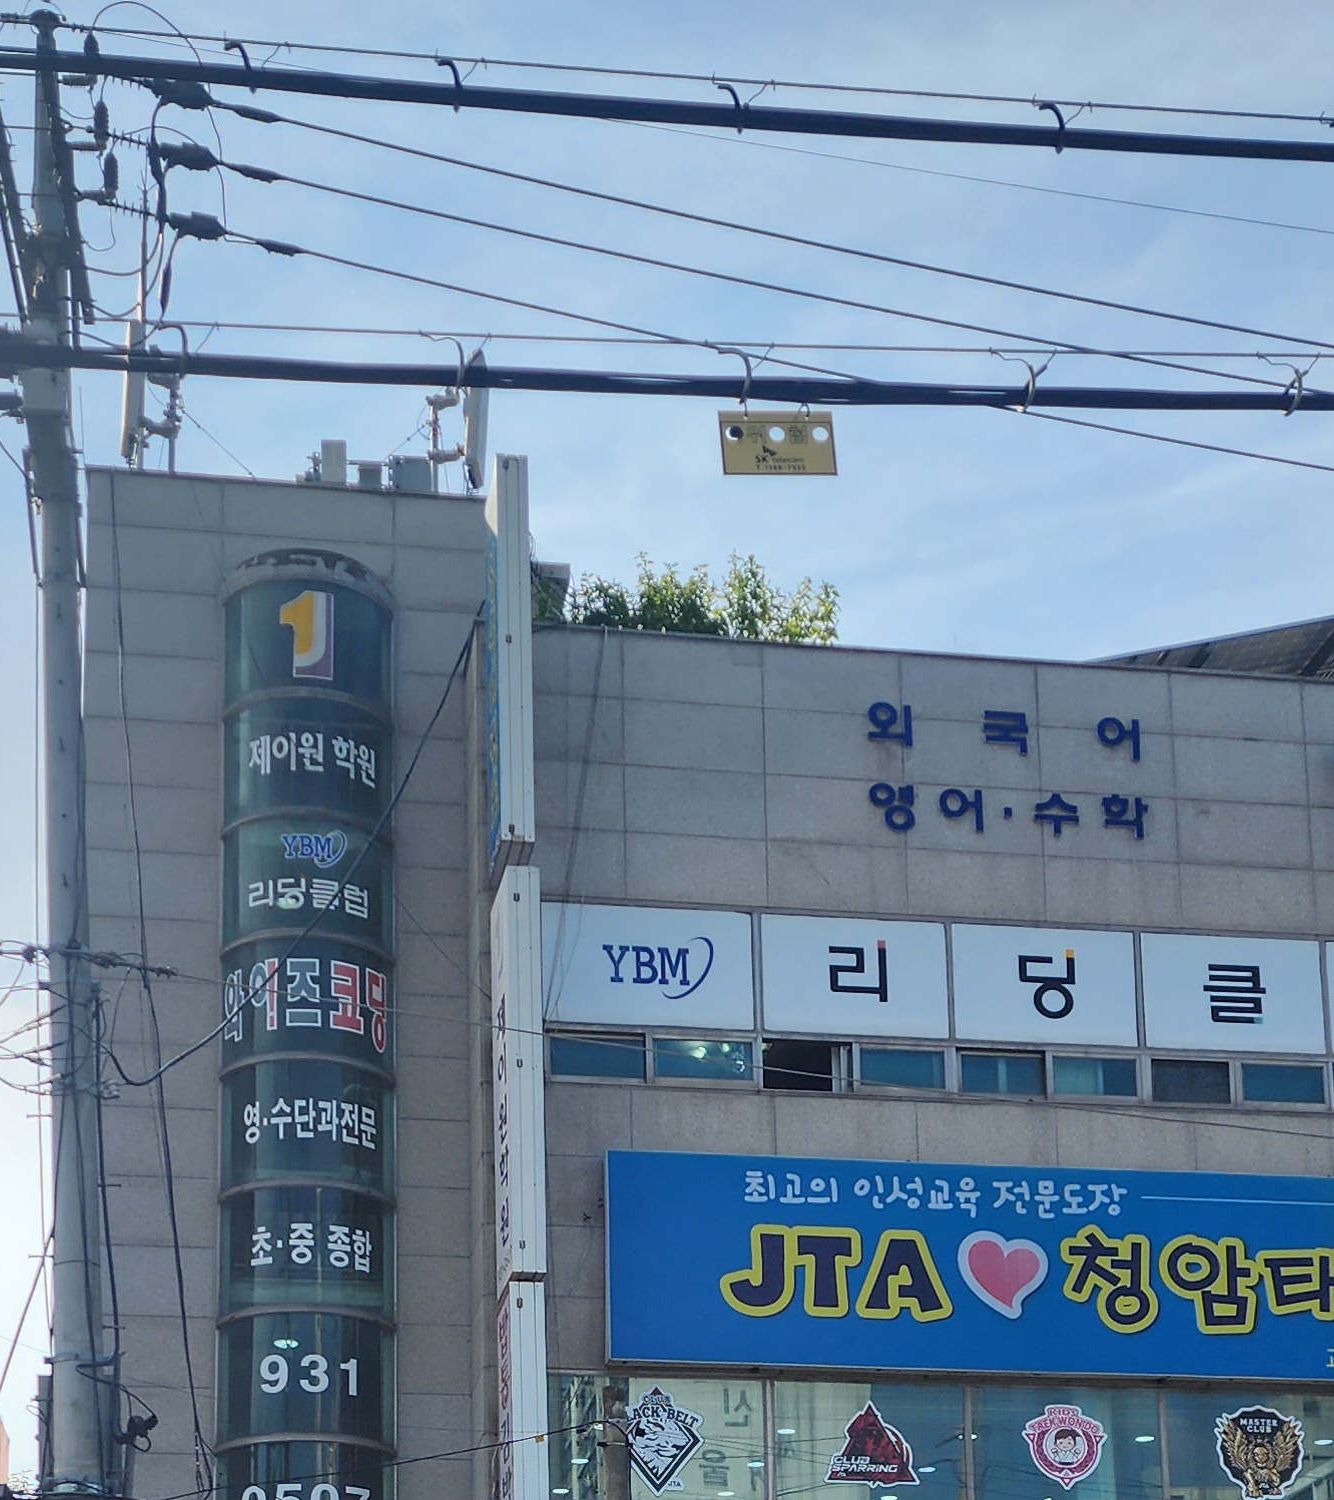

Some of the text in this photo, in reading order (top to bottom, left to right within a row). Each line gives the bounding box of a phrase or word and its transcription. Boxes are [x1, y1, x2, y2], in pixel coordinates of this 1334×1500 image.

[249, 731, 377, 789] 제이원 학원
[280, 834, 337, 861] YBM
[248, 877, 369, 919] 리딩클럽
[602, 943, 691, 988] YBM
[743, 1170, 1127, 1219] 최고의 인성교육 전문도장
[326, 1224, 373, 1273] 종합
[719, 1223, 955, 1324] JTA
[259, 1353, 360, 1397] 931
[643, 1395, 672, 1405] CLUB
[1047, 1407, 1079, 1418] KIDS
[667, 1408, 699, 1428] BELT
[1239, 1417, 1279, 1428] MASTER
[1246, 1425, 1273, 1435] CLUB
[833, 1455, 871, 1464] CLUB
